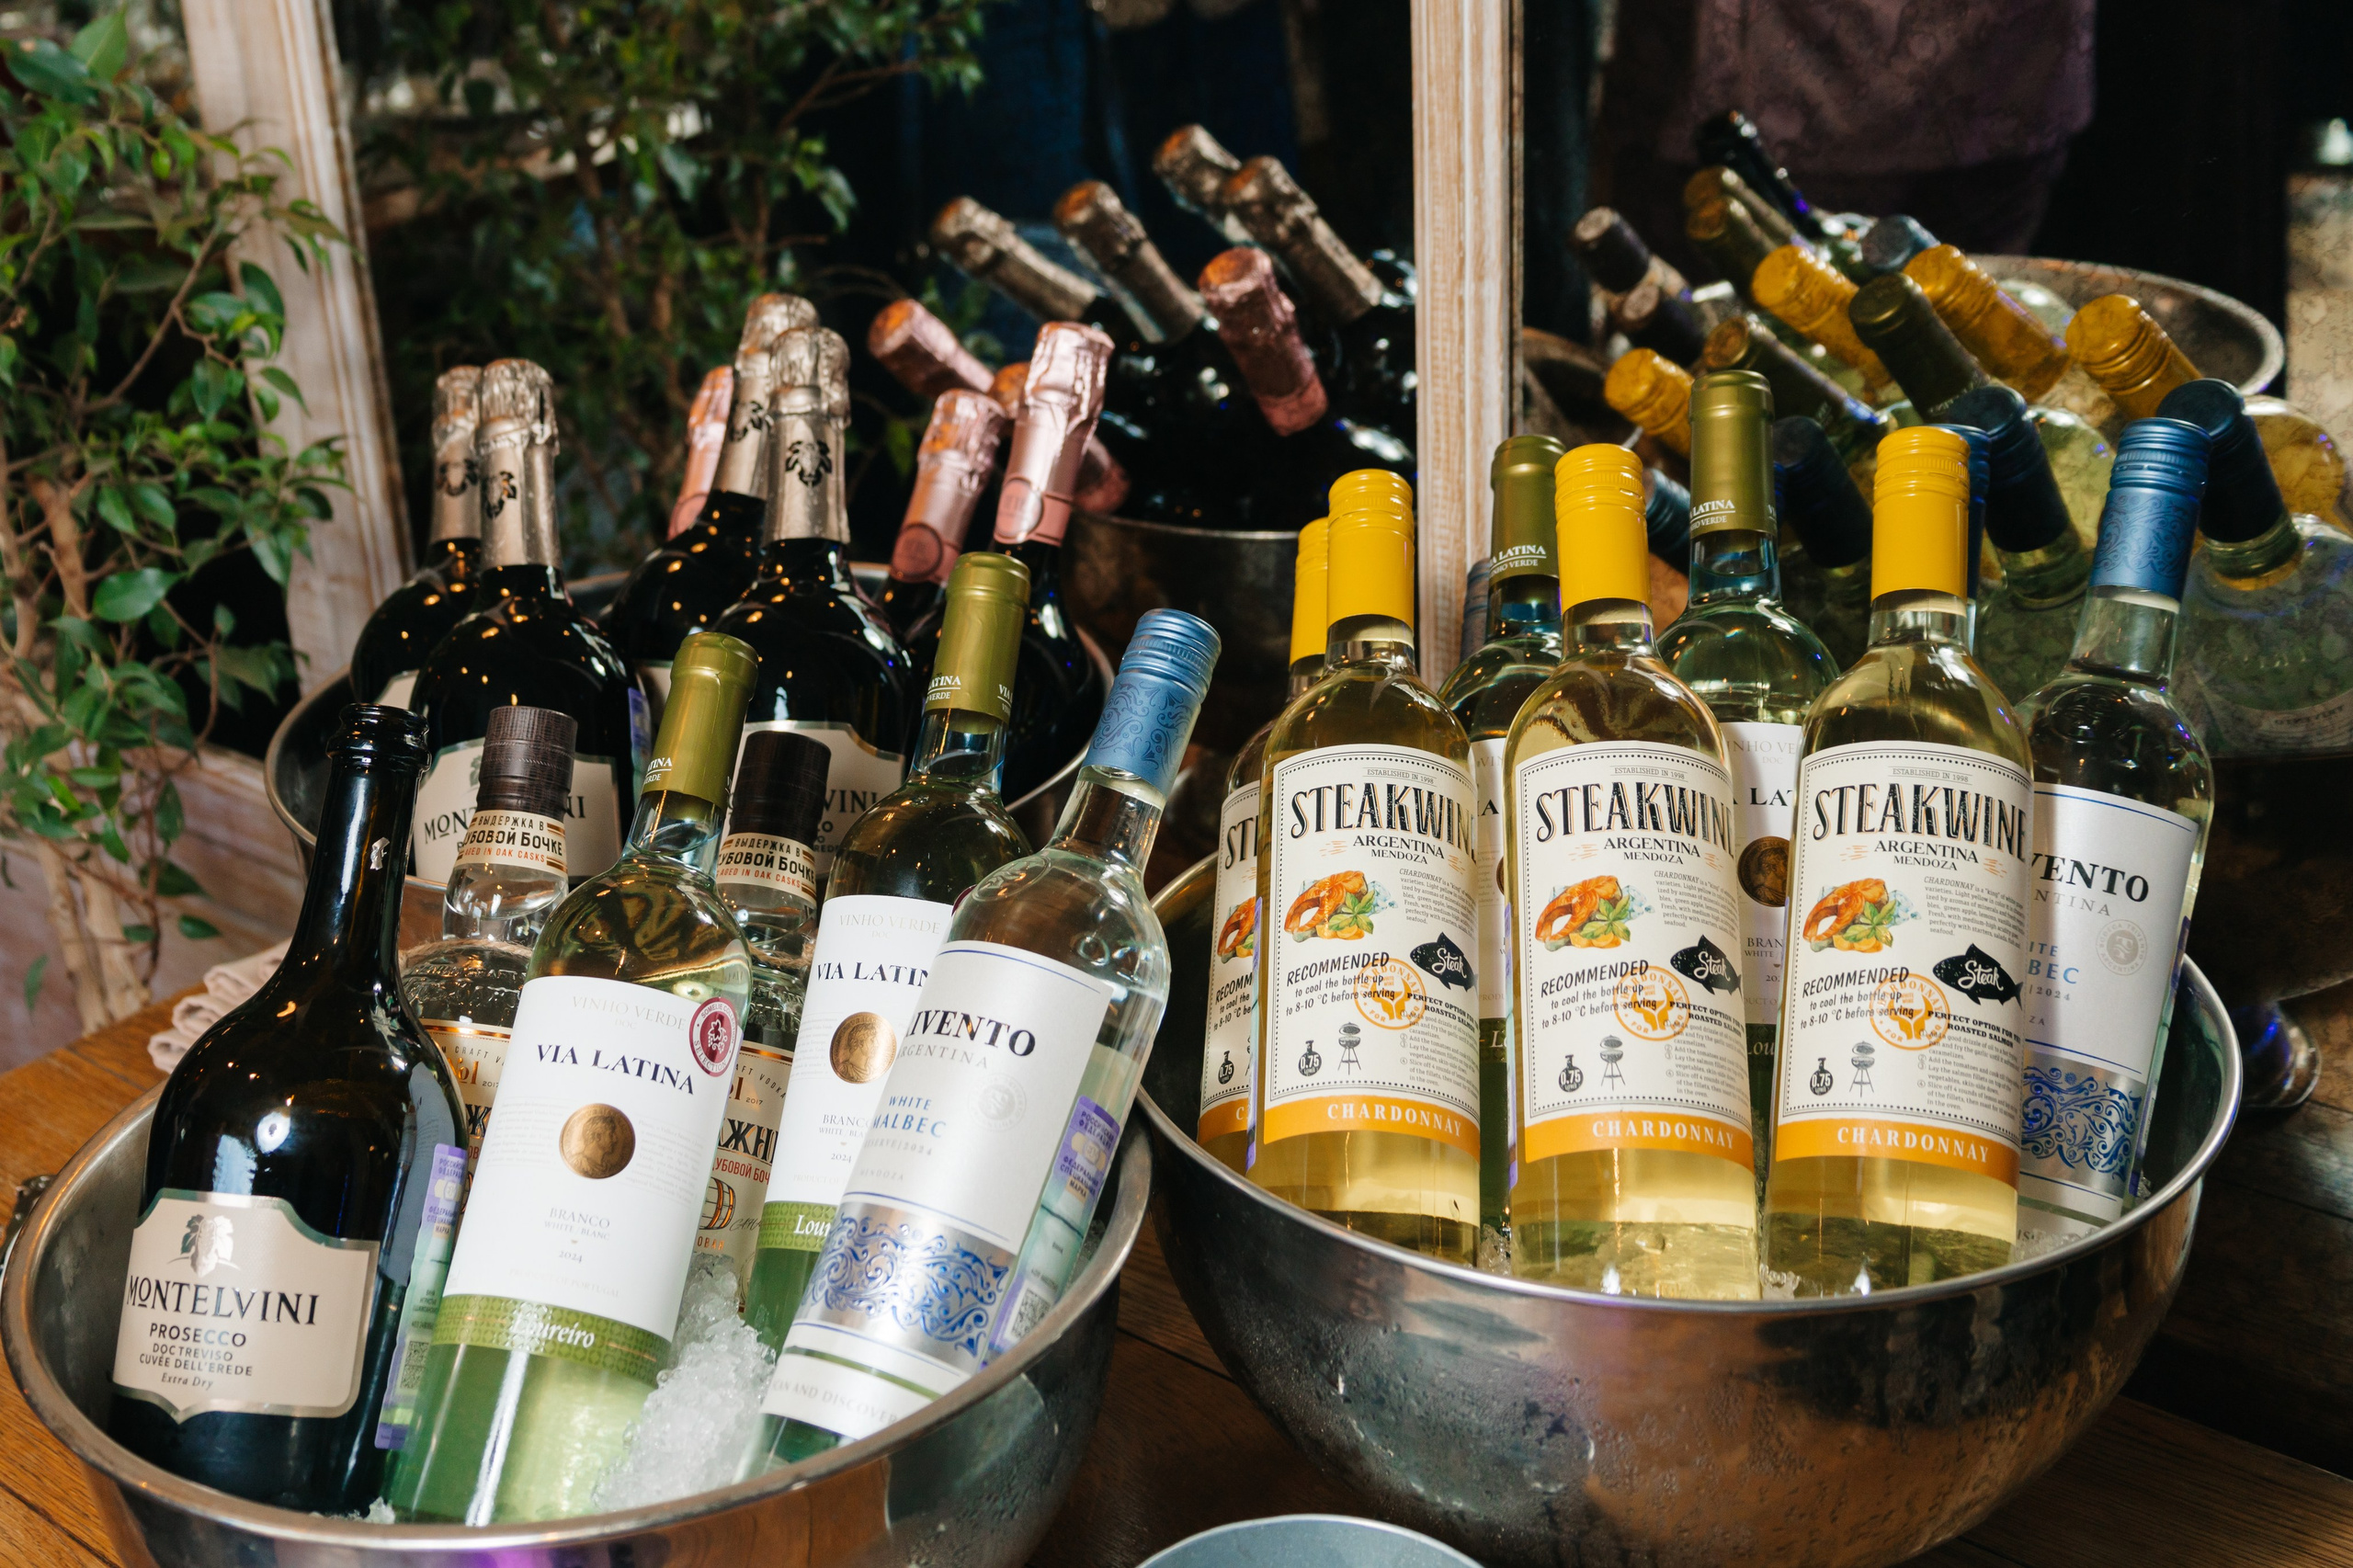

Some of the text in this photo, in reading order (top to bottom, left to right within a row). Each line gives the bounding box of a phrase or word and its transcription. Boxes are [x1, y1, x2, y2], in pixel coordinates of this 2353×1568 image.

[1693, 499, 1734, 516] LATINA
[1700, 515, 1727, 526] VERDE
[1498, 544, 1546, 559] LATINA
[1508, 559, 1539, 568] VERDE
[1367, 768, 1409, 778] ESTABLISHED
[1420, 775, 1435, 785] 1998
[1614, 767, 1660, 776] ESTABLISHED
[1671, 771, 1685, 779] 1998
[1893, 767, 1941, 779] ESTABLISHED
[1952, 774, 1969, 783] 1998
[478, 815, 544, 830] ВЫДЕРЖКА В
[465, 847, 481, 856] AGED
[496, 848, 513, 857] OAK
[518, 851, 545, 863] CASKS
[520, 835, 563, 856] БОЧКЕ
[735, 838, 801, 857] ВЫДЕРЖКА В
[1353, 835, 1445, 859] ARGENTINA
[1604, 837, 1700, 858] ARGENTINA
[1874, 840, 1979, 864] ARGENTINA
[1370, 849, 1428, 865] MENDOZA
[1623, 852, 1684, 865] MENDOZA
[1893, 855, 1958, 871] MENDOZA
[755, 870, 771, 880] OAK
[776, 874, 801, 888] CASKS
[779, 857, 814, 884] БОЧКЕ
[1399, 868, 1442, 882] CHARDONNAY
[1654, 870, 1699, 883] CHARDONNAY
[1924, 876, 1974, 891] CHARDONNAY
[1925, 886, 1988, 903] varieties. Light yellow
[1949, 898, 1970, 906] aromas
[1928, 910, 1946, 918] Fresh,
[1943, 903, 1961, 913] green
[838, 914, 941, 935] VINHO VERDE
[1929, 919, 1957, 929] perfectly
[1929, 927, 1955, 936] seafood.
[1287, 951, 1390, 987] RECOMMENDED
[1433, 947, 1467, 979] Steak
[1694, 950, 1731, 983] Steak
[817, 962, 928, 988] VIA LATIN
[1540, 960, 1649, 998] RECOMMENDED
[1802, 966, 1910, 998] RECOMMENDED
[1958, 960, 2004, 991] Steak
[1295, 973, 1384, 998] to cool the bottle up
[2036, 986, 2071, 1001] 2024
[1225, 993, 1249, 1011] cool the
[1286, 1006, 1293, 1017] to
[1295, 996, 1314, 1011] 8-10
[1331, 991, 1359, 1003] before
[1362, 989, 1395, 1001] serving
[1407, 993, 1466, 1017] PERFECT OPTION
[1551, 983, 1643, 1009] to cool the bottle up
[1810, 989, 1903, 1011] to cool the bottle up
[573, 995, 686, 1031] VINHO VERDE
[1425, 1005, 1457, 1020] ROASTED
[1541, 1018, 1550, 1029] to
[1552, 1010, 1572, 1024] 8-10
[1589, 1003, 1619, 1015] before
[1622, 998, 1657, 1010] serving
[1669, 1001, 1732, 1021] PERFECT OPTION
[1688, 1013, 1722, 1027] ROASTED
[1800, 1018, 1807, 1029] to
[1809, 1013, 1827, 1026] 8-10
[1845, 1006, 1875, 1018] before
[1879, 1006, 1914, 1018] serving
[1927, 1010, 2001, 1033] PERFECT OPTION
[1948, 1023, 2014, 1048] ROASTED SALMON
[455, 1046, 489, 1059] CRAFT
[695, 1040, 727, 1072] SELECTION
[1300, 1054, 1320, 1069] 0.75
[538, 1044, 694, 1095] VIA LATINA
[1559, 1068, 1581, 1084] 0.75
[1951, 1069, 1972, 1078] salmon
[1953, 1061, 1978, 1072] tomatoes
[759, 1074, 787, 1099] VODKA
[1811, 1073, 1831, 1088] 0.75
[889, 1096, 932, 1111] WHITE
[873, 1113, 947, 1138] MALBEC
[1327, 1103, 1462, 1137] CHARDONNAY
[819, 1127, 843, 1135] WHITE
[1592, 1119, 1735, 1150] CHARDONNAY
[1837, 1127, 1989, 1164] CHARDONNAY
[831, 1153, 852, 1164] 2024
[1069, 1179, 1087, 1198] МАРКА
[550, 1207, 610, 1229] BRANCO
[544, 1220, 610, 1241] WHITE BLANC
[558, 1250, 583, 1263] 2024
[126, 1275, 320, 1325] MONTELVINI
[149, 1323, 246, 1347] PROSECCO
[510, 1315, 595, 1348] Loureiro
[174, 1358, 253, 1377] DELL'EREDE
[161, 1372, 214, 1391] Extra Dry
[794, 1385, 819, 1399] AND
